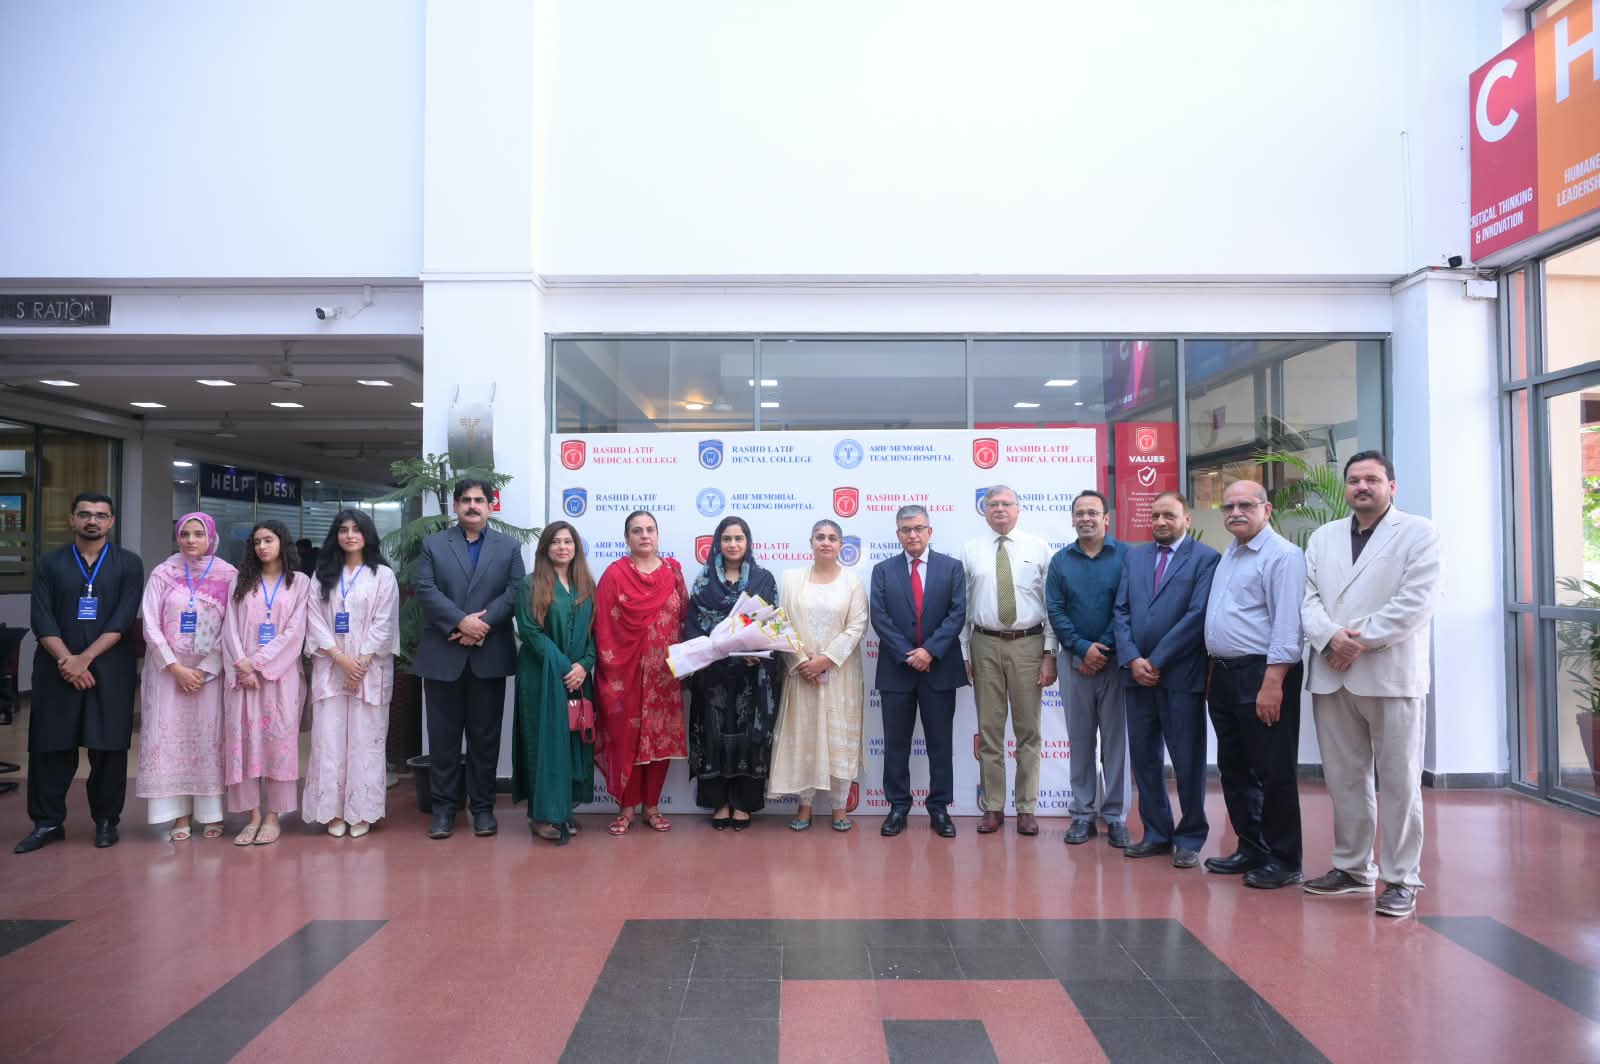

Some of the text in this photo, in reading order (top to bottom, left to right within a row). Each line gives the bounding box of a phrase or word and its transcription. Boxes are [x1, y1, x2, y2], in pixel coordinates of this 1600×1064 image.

[1476, 58, 1519, 143] C
[1498, 187, 1532, 215] THINKING
[1475, 209, 1524, 245] & INNOVATION
[593, 446, 655, 454] RASHID LATIF
[732, 445, 794, 453] RASHID LATIF
[1006, 445, 1071, 453] RASHID LATIF
[593, 456, 679, 464] MEDICAL COLLEGE
[732, 455, 813, 463] DENTAL COLLEGE
[869, 454, 954, 462] TEACHING HOSPITAL
[1006, 455, 1096, 463] MEDICAL COLLEGE
[1128, 455, 1166, 463] VALUES
[211, 472, 297, 499] HELP DESK
[595, 493, 658, 501] RASHID LATIF
[731, 493, 797, 501] ARIF MEMORIAL
[866, 494, 930, 502] RASHID LATIF
[1018, 493, 1074, 501] ASHID LATIF
[595, 504, 677, 512] DENTAL COLLEGE
[1022, 504, 1047, 512] NTAL
[594, 541, 614, 549] ARIF
[764, 542, 790, 550] LATIF
[594, 551, 631, 559] TEACHIN
